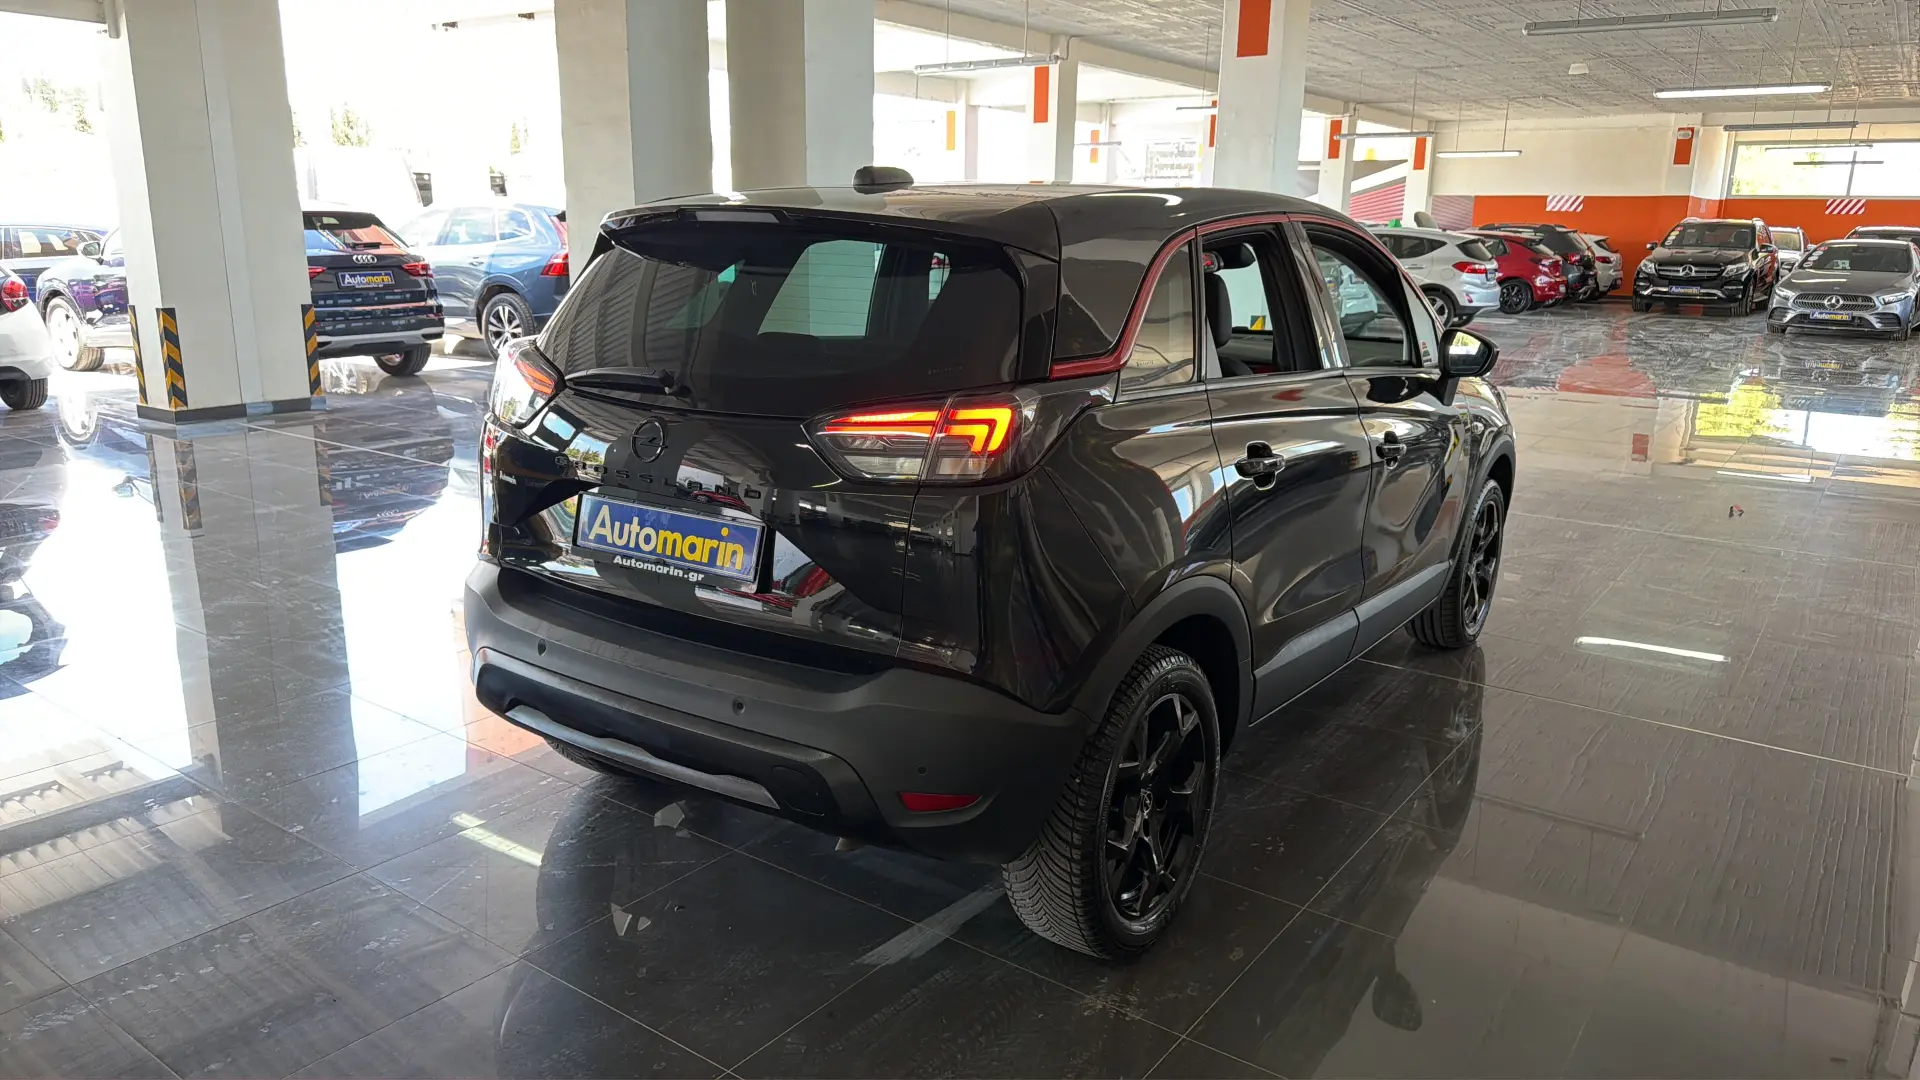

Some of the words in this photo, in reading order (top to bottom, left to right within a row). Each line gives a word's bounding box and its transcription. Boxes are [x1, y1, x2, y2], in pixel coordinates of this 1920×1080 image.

[344, 272, 392, 285] Automarin
[1811, 311, 1849, 320] Automarin
[588, 504, 745, 571] Automarin
[613, 555, 705, 582] Automarin.gr
